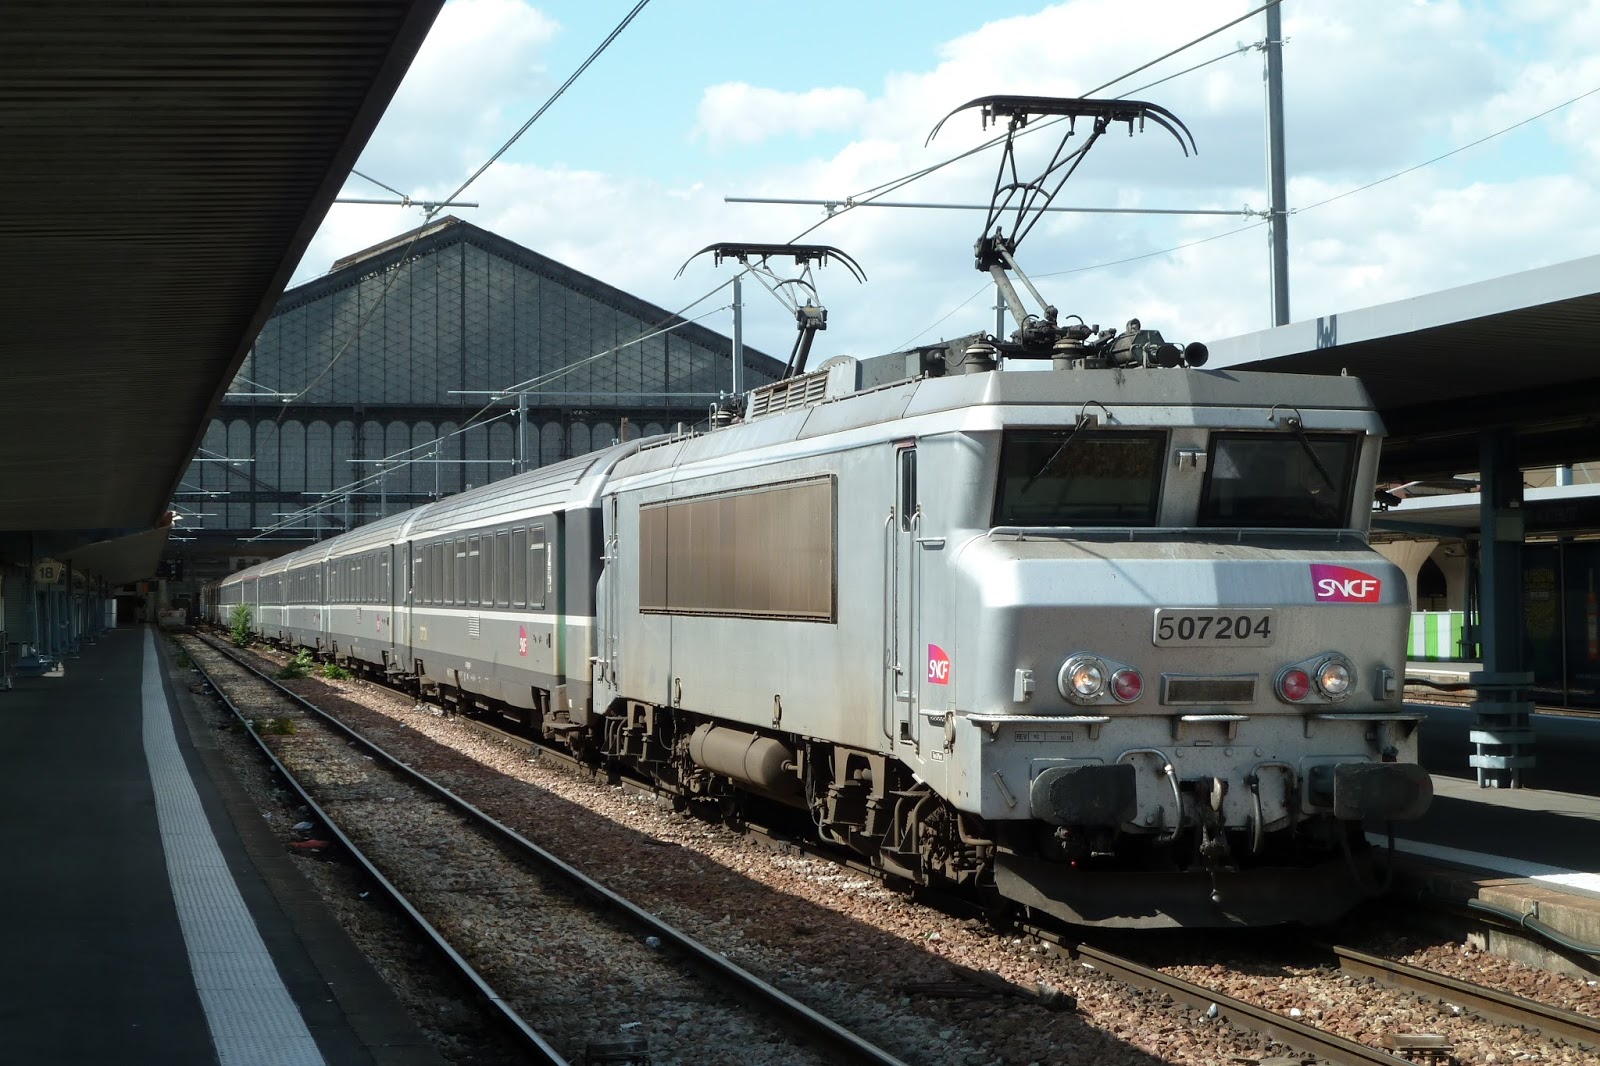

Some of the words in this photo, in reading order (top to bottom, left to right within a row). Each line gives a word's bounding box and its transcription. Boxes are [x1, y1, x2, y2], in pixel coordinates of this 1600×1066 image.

[40, 567, 54, 578] 18
[1317, 578, 1377, 598] SNCF
[1158, 616, 1273, 641] 507204
[928, 659, 949, 680] SNCF
